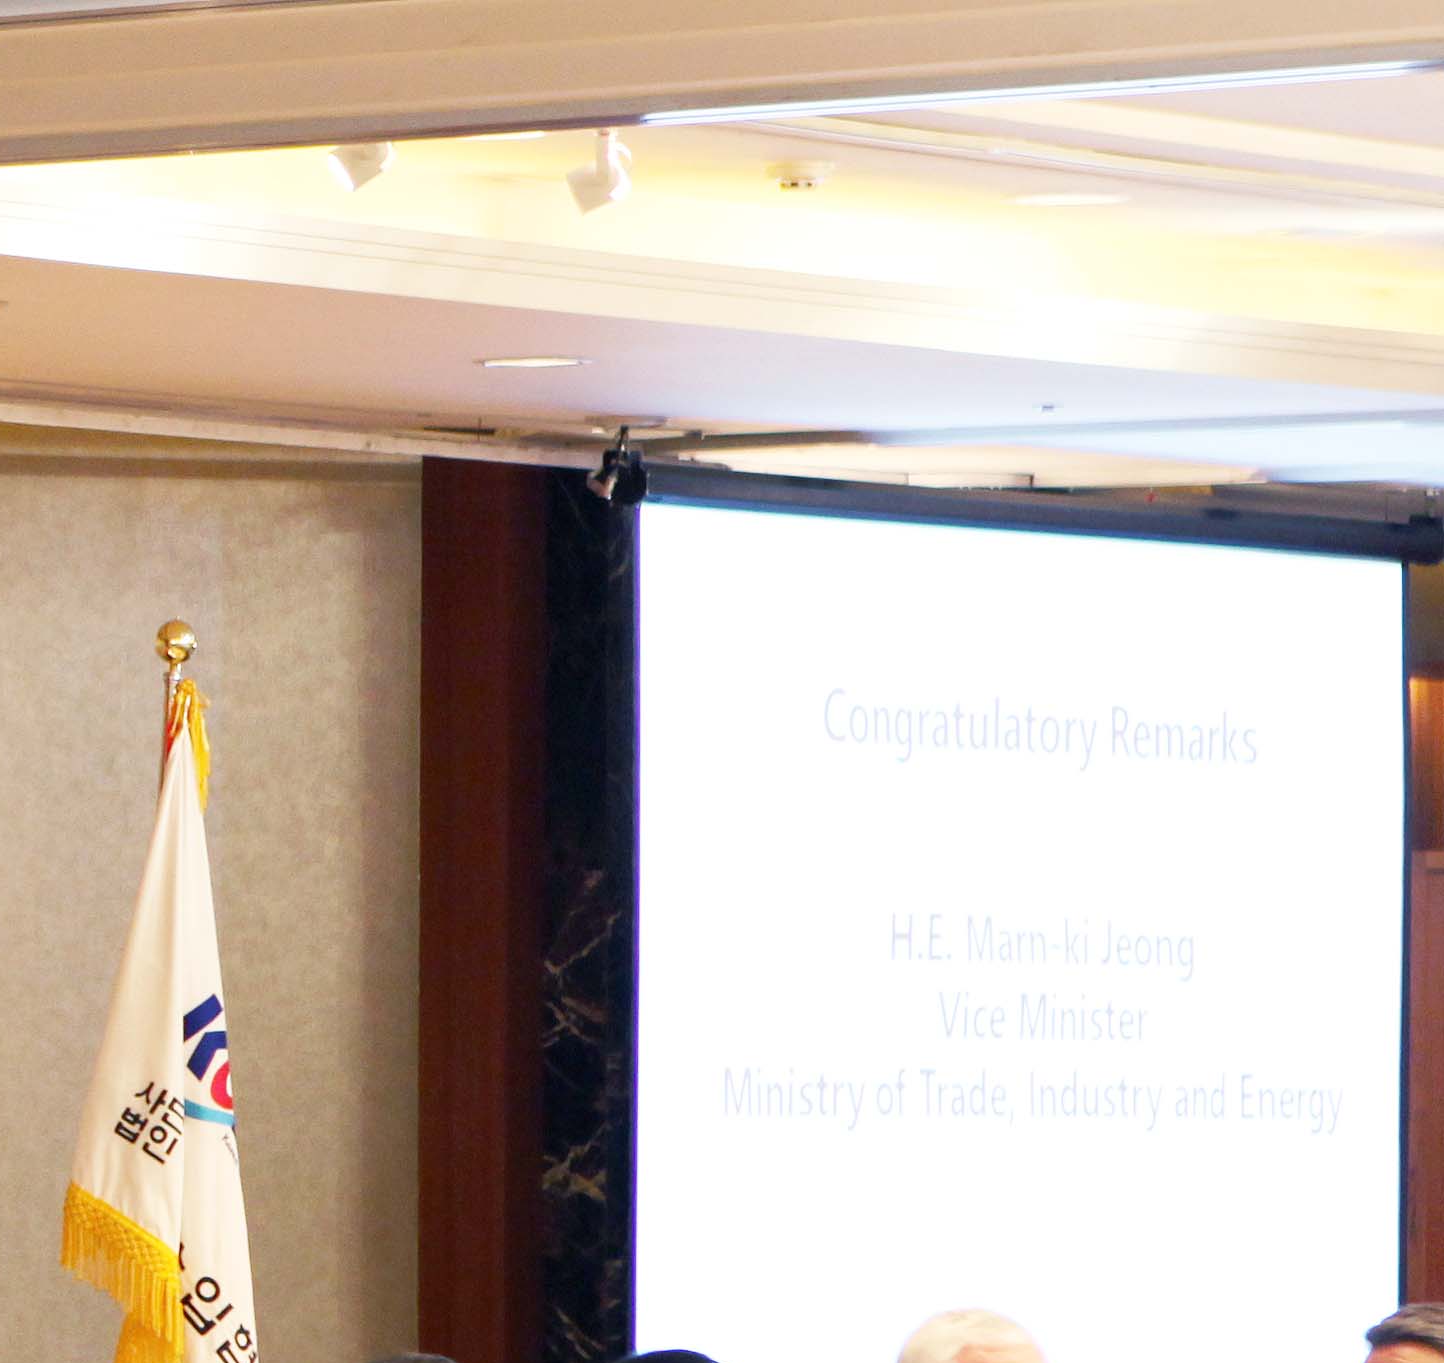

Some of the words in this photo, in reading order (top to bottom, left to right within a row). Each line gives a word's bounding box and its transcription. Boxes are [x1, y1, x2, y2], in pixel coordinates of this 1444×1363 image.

[823, 687, 1098, 771] Congratulatory
[1110, 705, 1258, 765] Remarks
[890, 912, 953, 962] H.E.
[967, 915, 1089, 965] Marn-ki
[1102, 921, 1196, 982] Jeong
[938, 991, 1006, 1040] Vice
[1019, 992, 1148, 1041] Minister
[722, 1067, 865, 1130] Ministry
[875, 1069, 906, 1117] of
[919, 1068, 1015, 1125] Trade,
[1030, 1071, 1162, 1131] Industry
[1173, 1074, 1225, 1120] and
[1240, 1072, 1342, 1134] Energy
